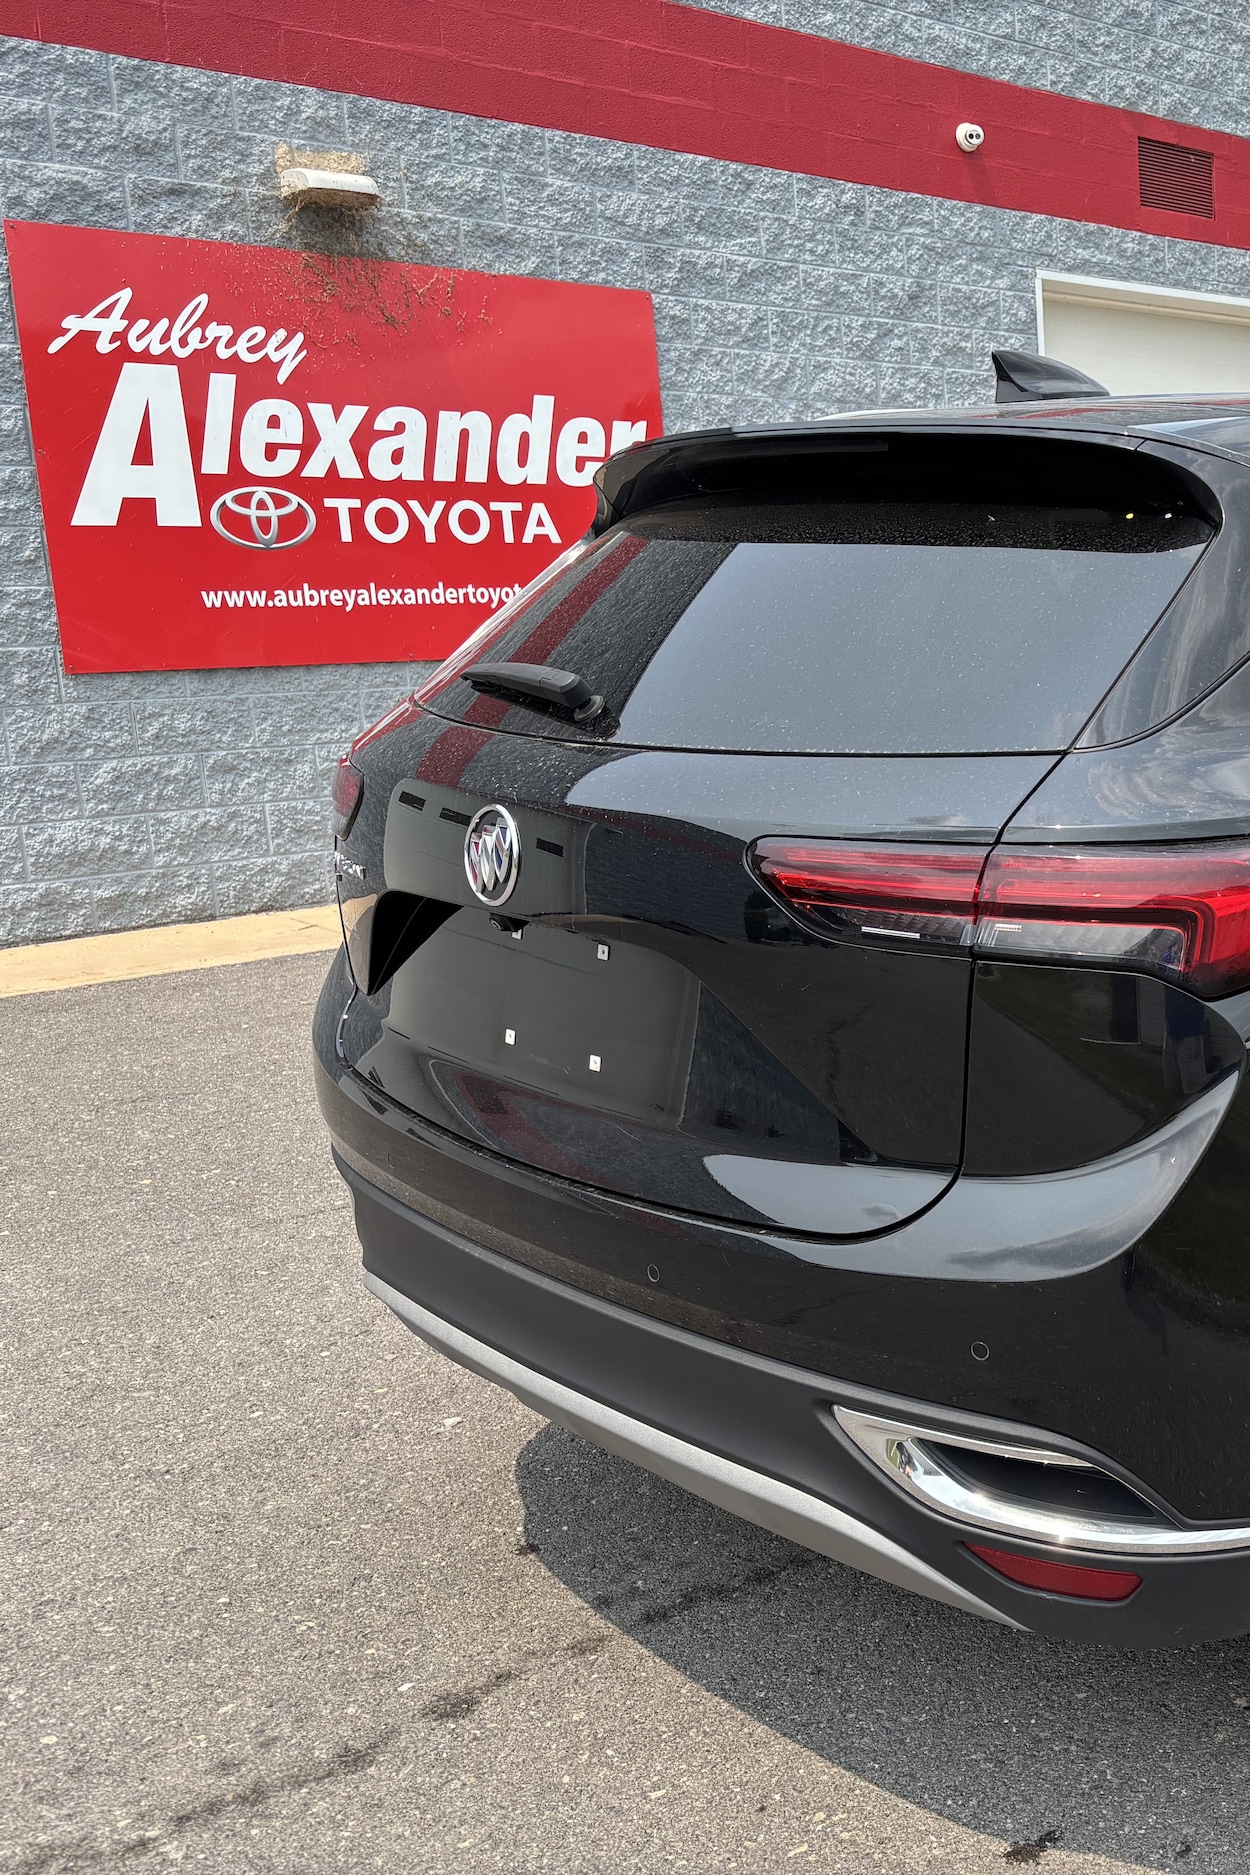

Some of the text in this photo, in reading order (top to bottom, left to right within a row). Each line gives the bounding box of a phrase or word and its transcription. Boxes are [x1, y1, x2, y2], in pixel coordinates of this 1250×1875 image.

[47, 286, 307, 384] Aubrey
[70, 361, 648, 528] Alexander
[323, 497, 562, 544] TOYOTA
